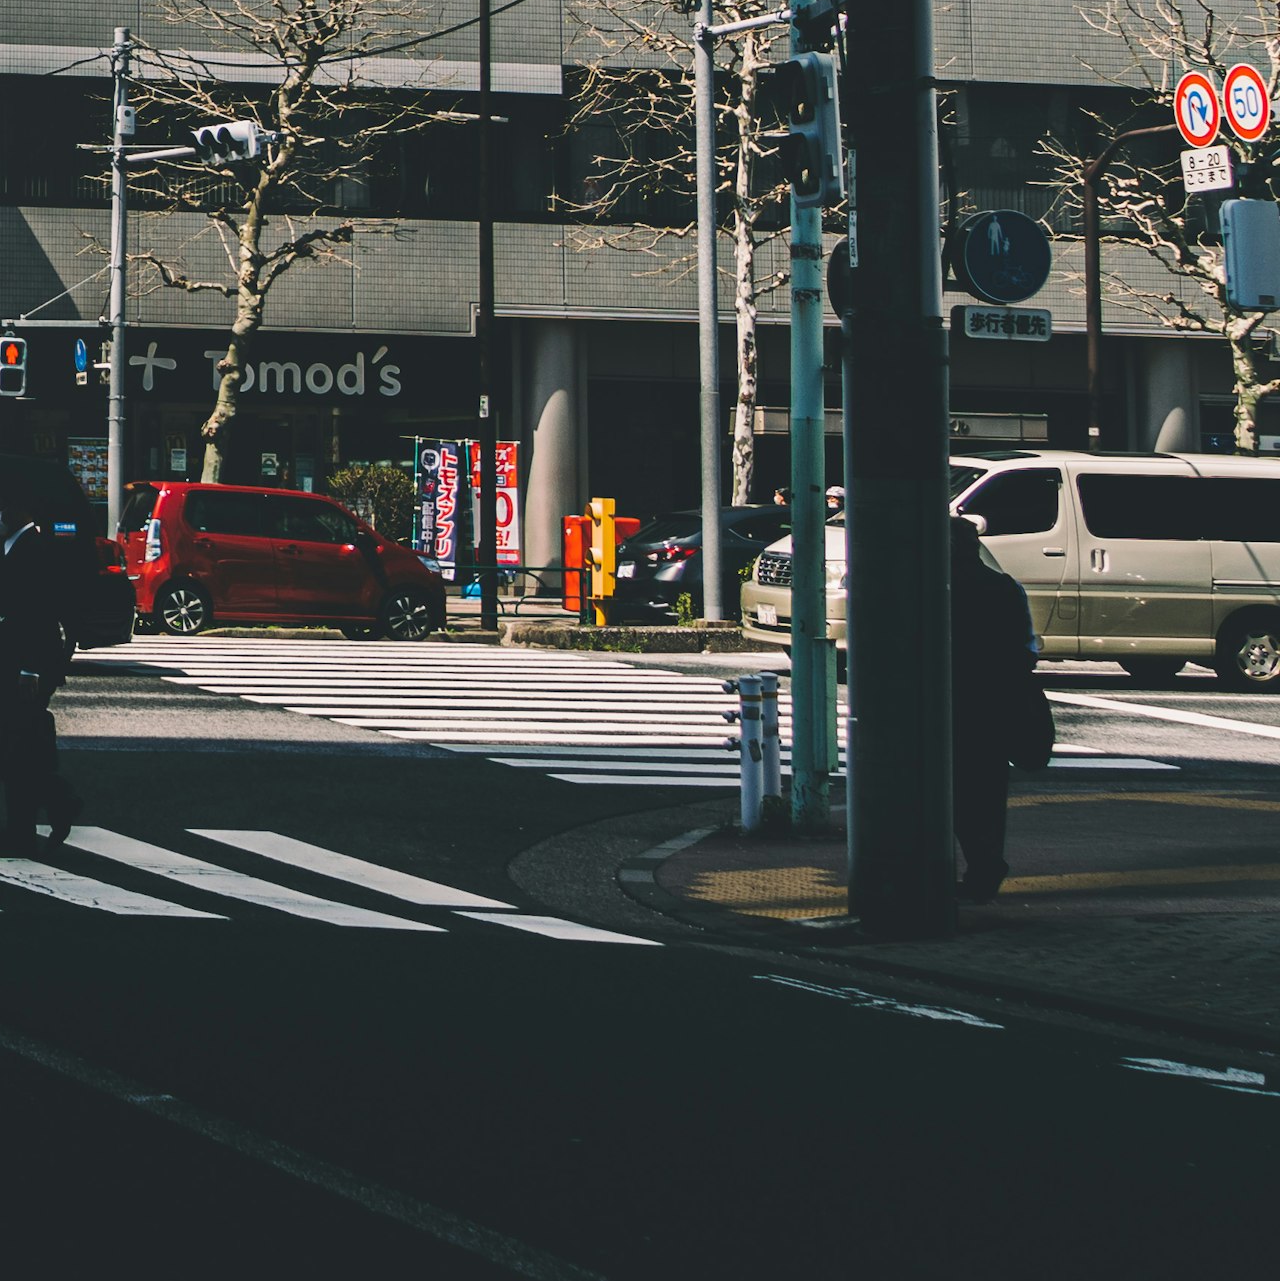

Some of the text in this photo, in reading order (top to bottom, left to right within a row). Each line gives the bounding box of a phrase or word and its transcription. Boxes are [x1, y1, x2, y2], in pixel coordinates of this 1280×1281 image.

[1233, 86, 1259, 118] 50
[1187, 169, 1227, 185] ここまで
[969, 312, 1046, 336] 歩行者優先
[436, 448, 458, 559] トモズアプリ
